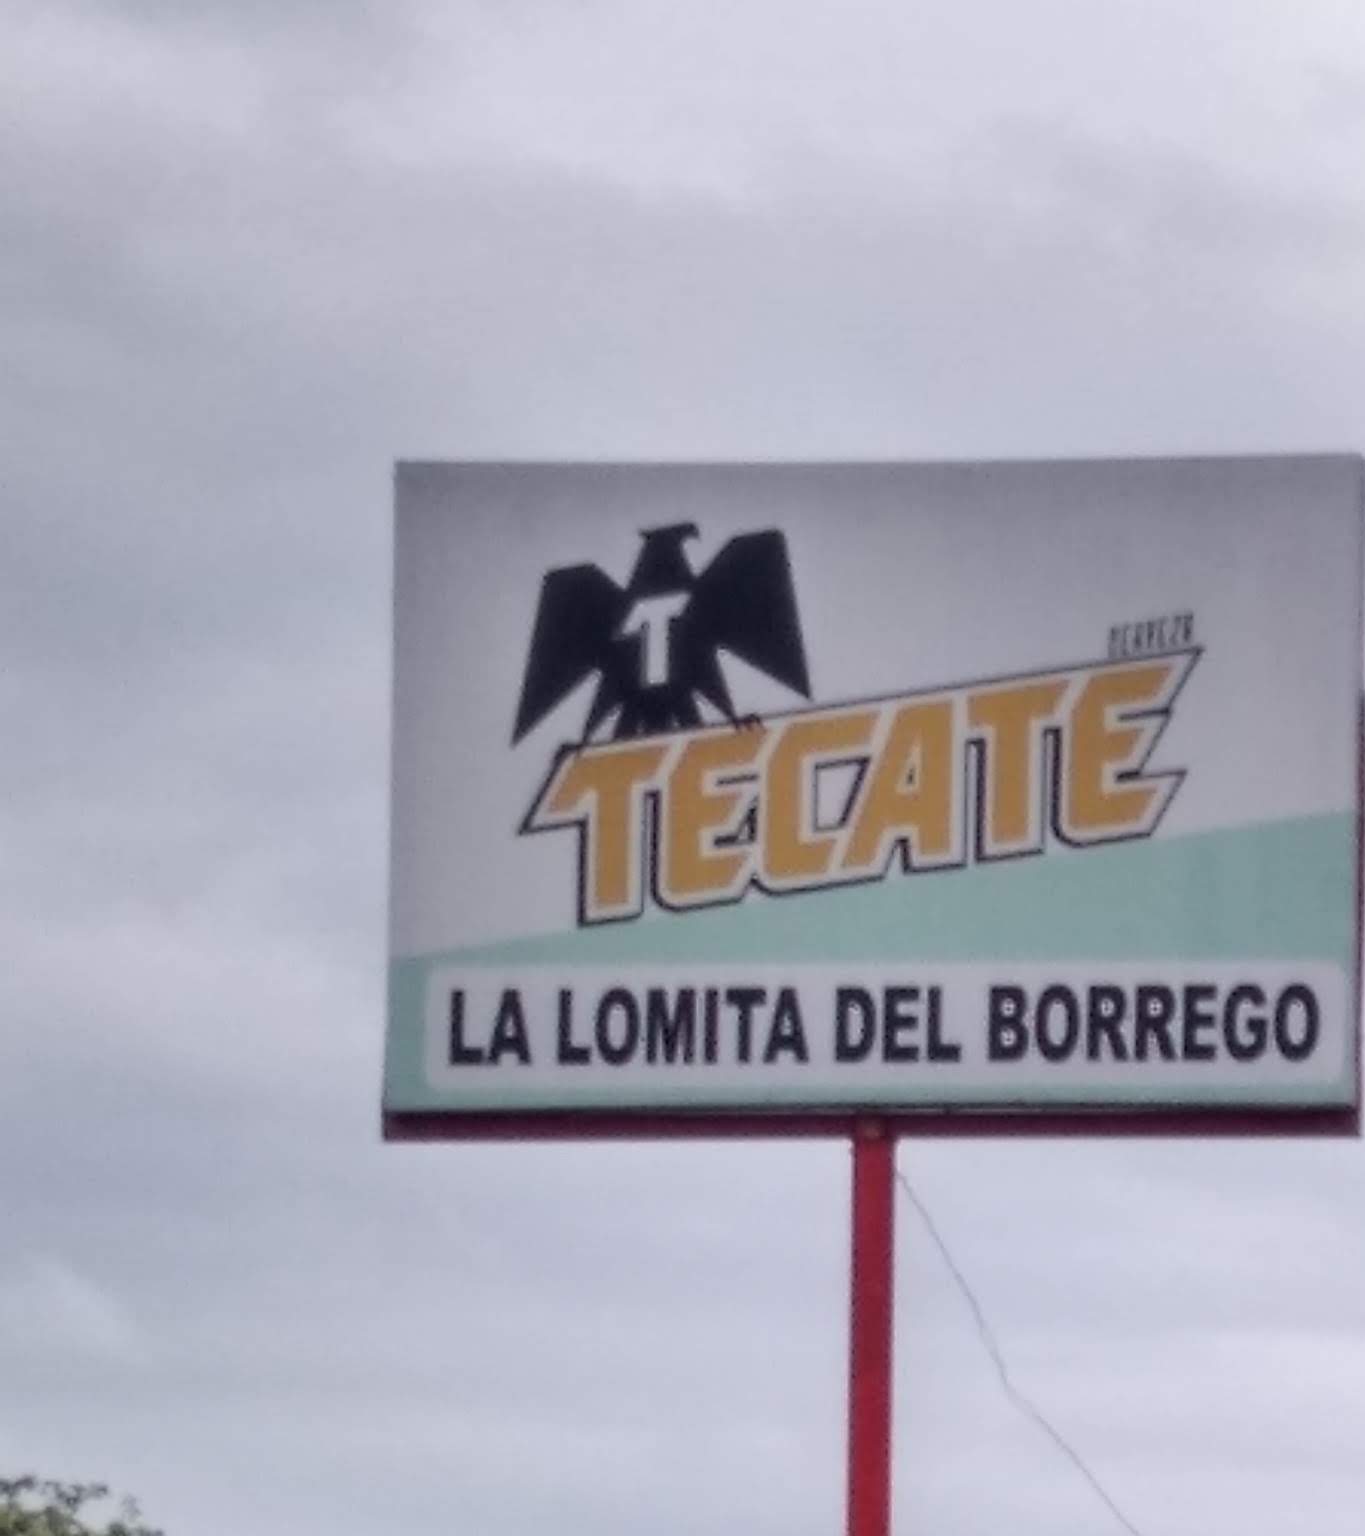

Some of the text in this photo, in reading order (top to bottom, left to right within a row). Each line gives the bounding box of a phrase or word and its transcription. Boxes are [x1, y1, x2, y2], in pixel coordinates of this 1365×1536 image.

[516, 646, 1204, 928] TECATE
[449, 983, 1321, 1066] LA LOMITA DEL BORREGO
